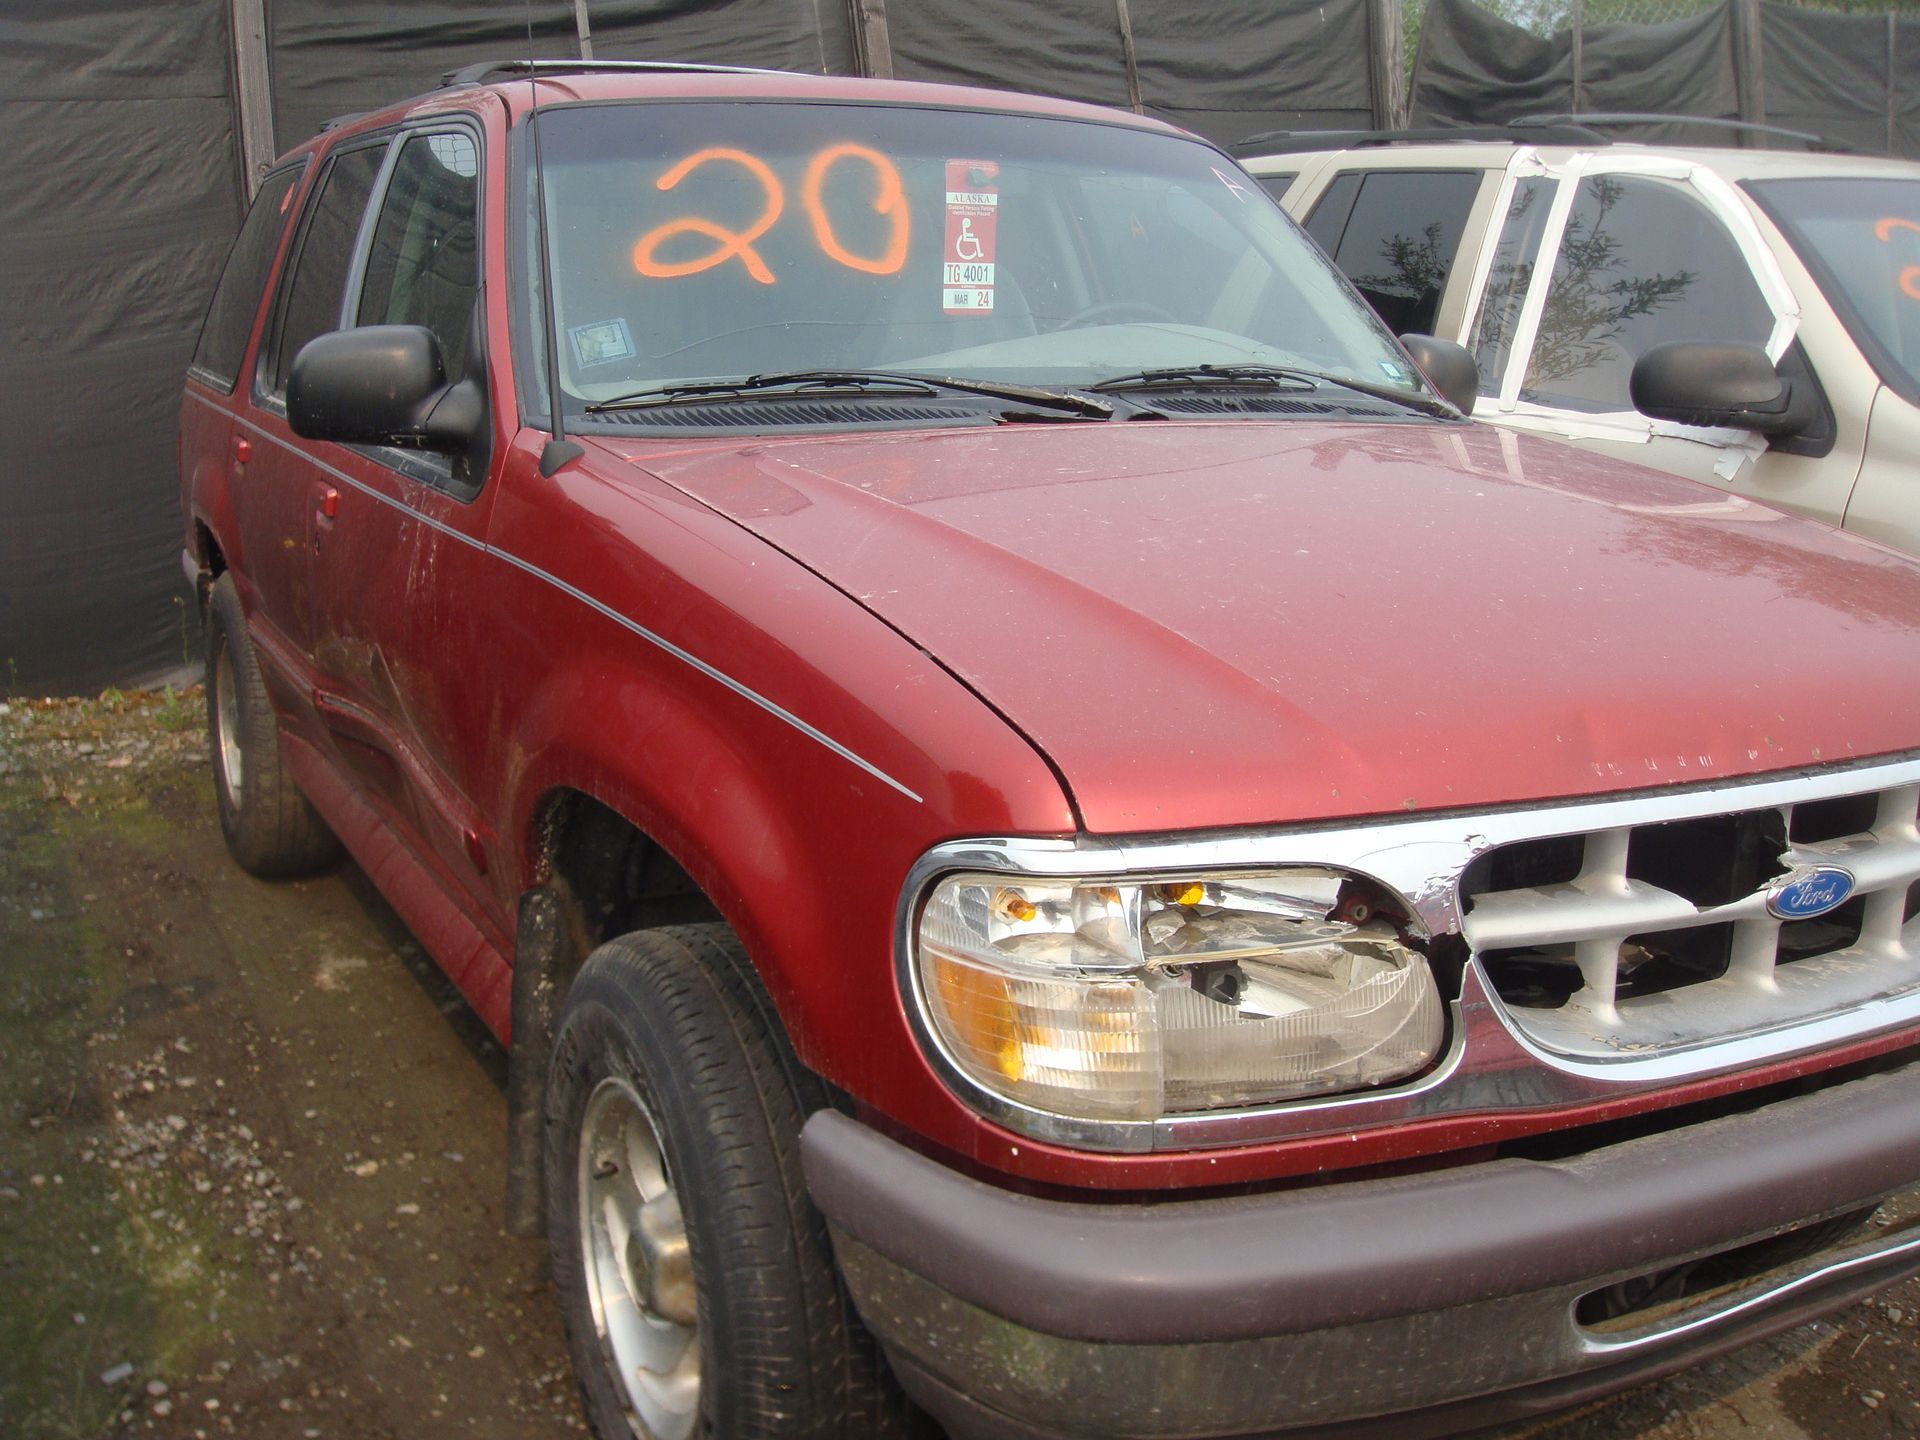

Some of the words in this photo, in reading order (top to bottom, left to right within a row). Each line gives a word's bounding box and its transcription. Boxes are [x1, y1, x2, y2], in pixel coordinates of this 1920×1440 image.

[953, 193, 991, 204] ALASKA
[633, 145, 910, 284] 20
[947, 264, 961, 283] TG
[963, 264, 989, 282] 4001
[954, 294, 969, 305] MAR
[977, 291, 990, 307] 24
[1791, 876, 1837, 908] Ford
